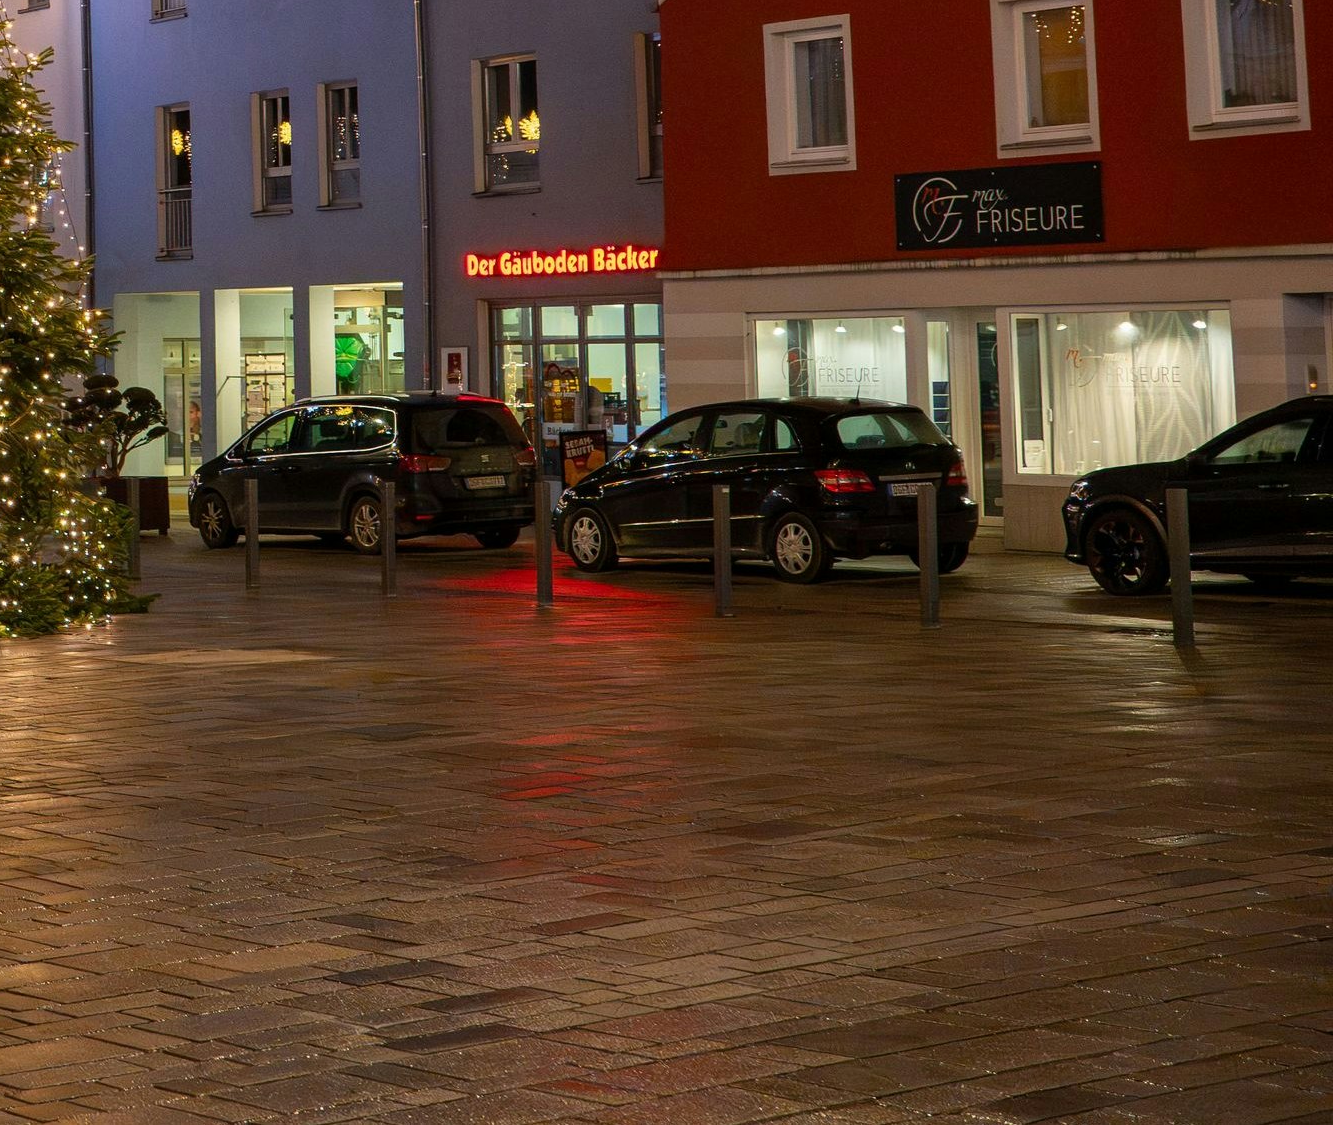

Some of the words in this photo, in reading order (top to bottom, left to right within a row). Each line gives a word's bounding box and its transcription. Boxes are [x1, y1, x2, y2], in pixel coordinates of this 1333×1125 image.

[976, 204, 1085, 234] FRISEURE
[466, 253, 496, 276] Der
[499, 249, 588, 276] Gäuboden
[592, 245, 659, 272] Bäcker
[818, 366, 880, 383] FRISEURE
[1105, 366, 1182, 383] FRISEURE
